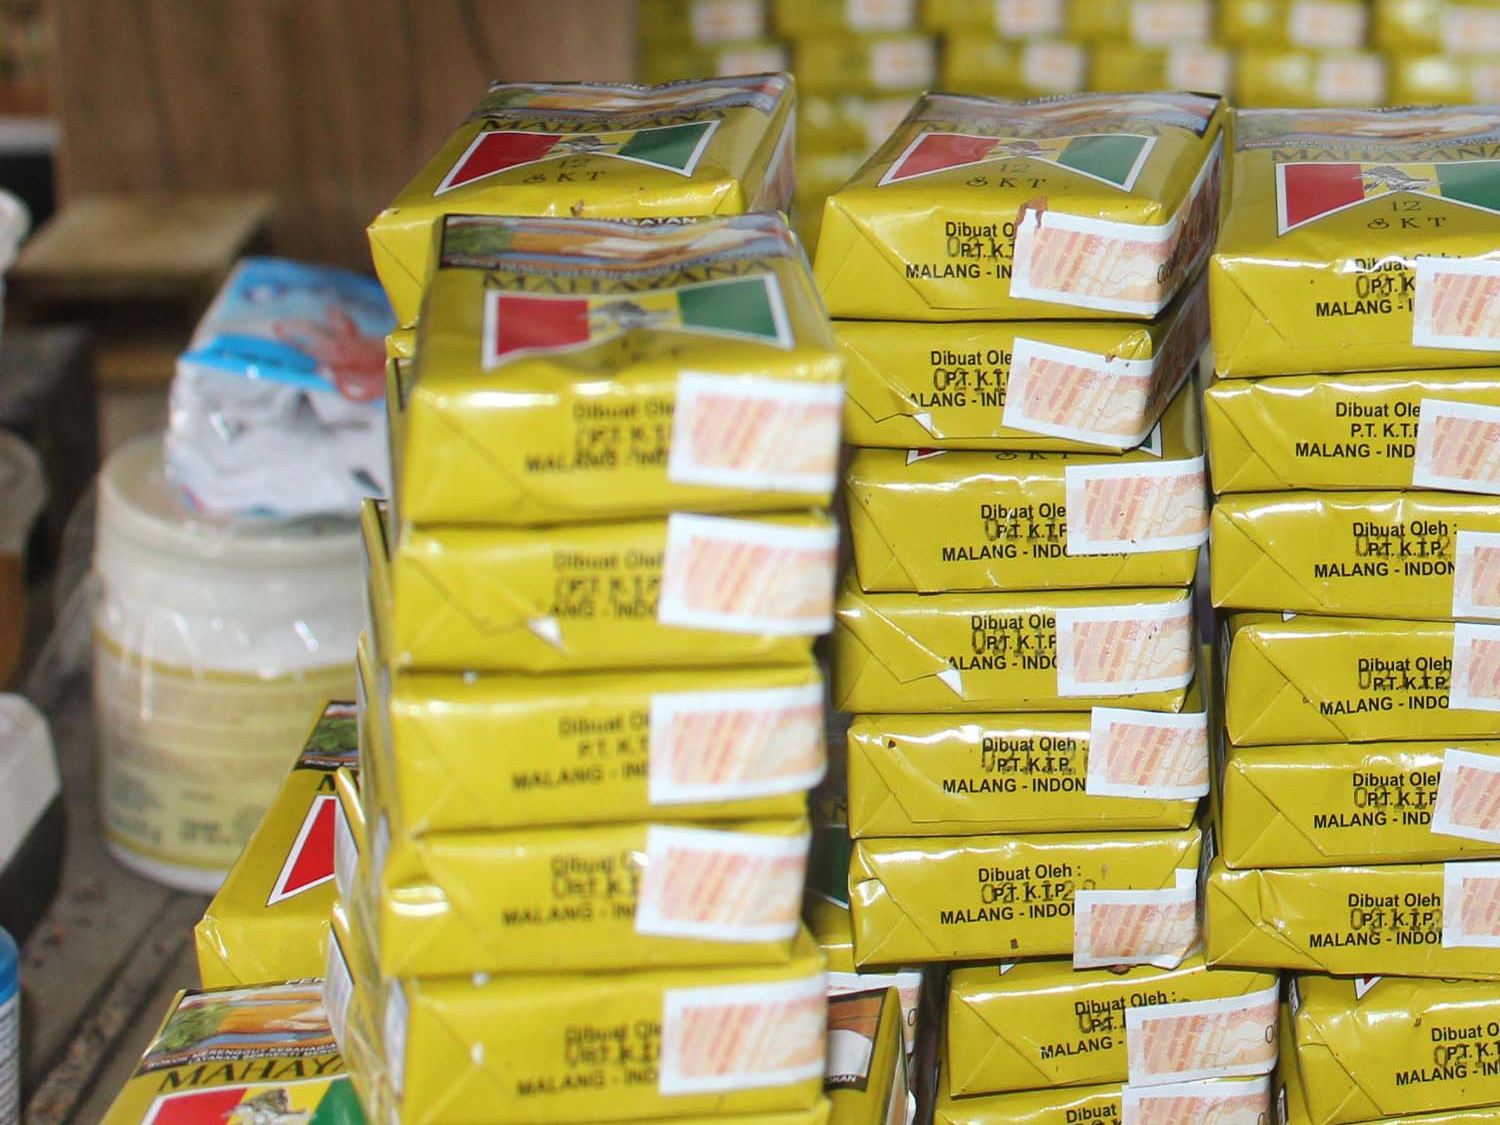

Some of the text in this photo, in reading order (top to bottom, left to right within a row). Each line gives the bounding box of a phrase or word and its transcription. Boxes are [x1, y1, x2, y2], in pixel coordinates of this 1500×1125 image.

[999, 163, 1032, 173] 12
[1390, 200, 1422, 212] 12
[945, 221, 998, 237] Dibuat
[906, 264, 980, 279] MALANG
[996, 264, 1012, 279] IN
[1354, 258, 1409, 274] Dibuat
[1316, 300, 1392, 317] MALANG
[930, 350, 1012, 366] Dibuat Ole
[911, 393, 966, 407] ALANG
[982, 393, 1006, 407] IND
[1335, 401, 1421, 417] Dibuat Ole
[1351, 423, 1377, 438] P.T.
[1295, 442, 1371, 458] MALANG
[1386, 444, 1416, 458] IND
[980, 503, 1066, 519] Dibuat Ole
[1030, 523, 1067, 539] K.T.P
[1353, 522, 1406, 537] Dibuat
[1410, 520, 1449, 535] Oleh
[942, 545, 1017, 561] MALANG
[1314, 562, 1389, 578] MALANG
[1404, 561, 1456, 577] INDON
[971, 614, 1056, 630] Dibuat Ole
[1020, 635, 1056, 650] K.T.P
[948, 656, 1006, 670] ALANG
[1358, 656, 1453, 673] Dibuat Oleh
[1320, 696, 1393, 716] MALANG
[1408, 695, 1450, 710] INDO
[982, 737, 1034, 752] Dibuat
[1039, 736, 1076, 752] Oleh
[943, 778, 1017, 794] MALANG
[1032, 777, 1086, 792] INDON
[1352, 773, 1405, 788] Dibuat
[1399, 791, 1438, 807] K.T.P
[1313, 811, 1387, 829] MALANG
[1402, 811, 1433, 826] IND
[978, 866, 1031, 883] Dibuat
[1035, 863, 1072, 879] Oleh
[1348, 892, 1441, 907] Dibuat Oleh
[940, 906, 1014, 925] MALANG
[1309, 931, 1381, 949] MALANG
[1074, 996, 1126, 1017] Dibuat
[1130, 991, 1168, 1008] Oleh
[1431, 1024, 1482, 1042] Dibuat
[1041, 1035, 1113, 1059] MALANG
[1396, 1065, 1467, 1084] MALANG
[1066, 1103, 1118, 1124] Dibuat
